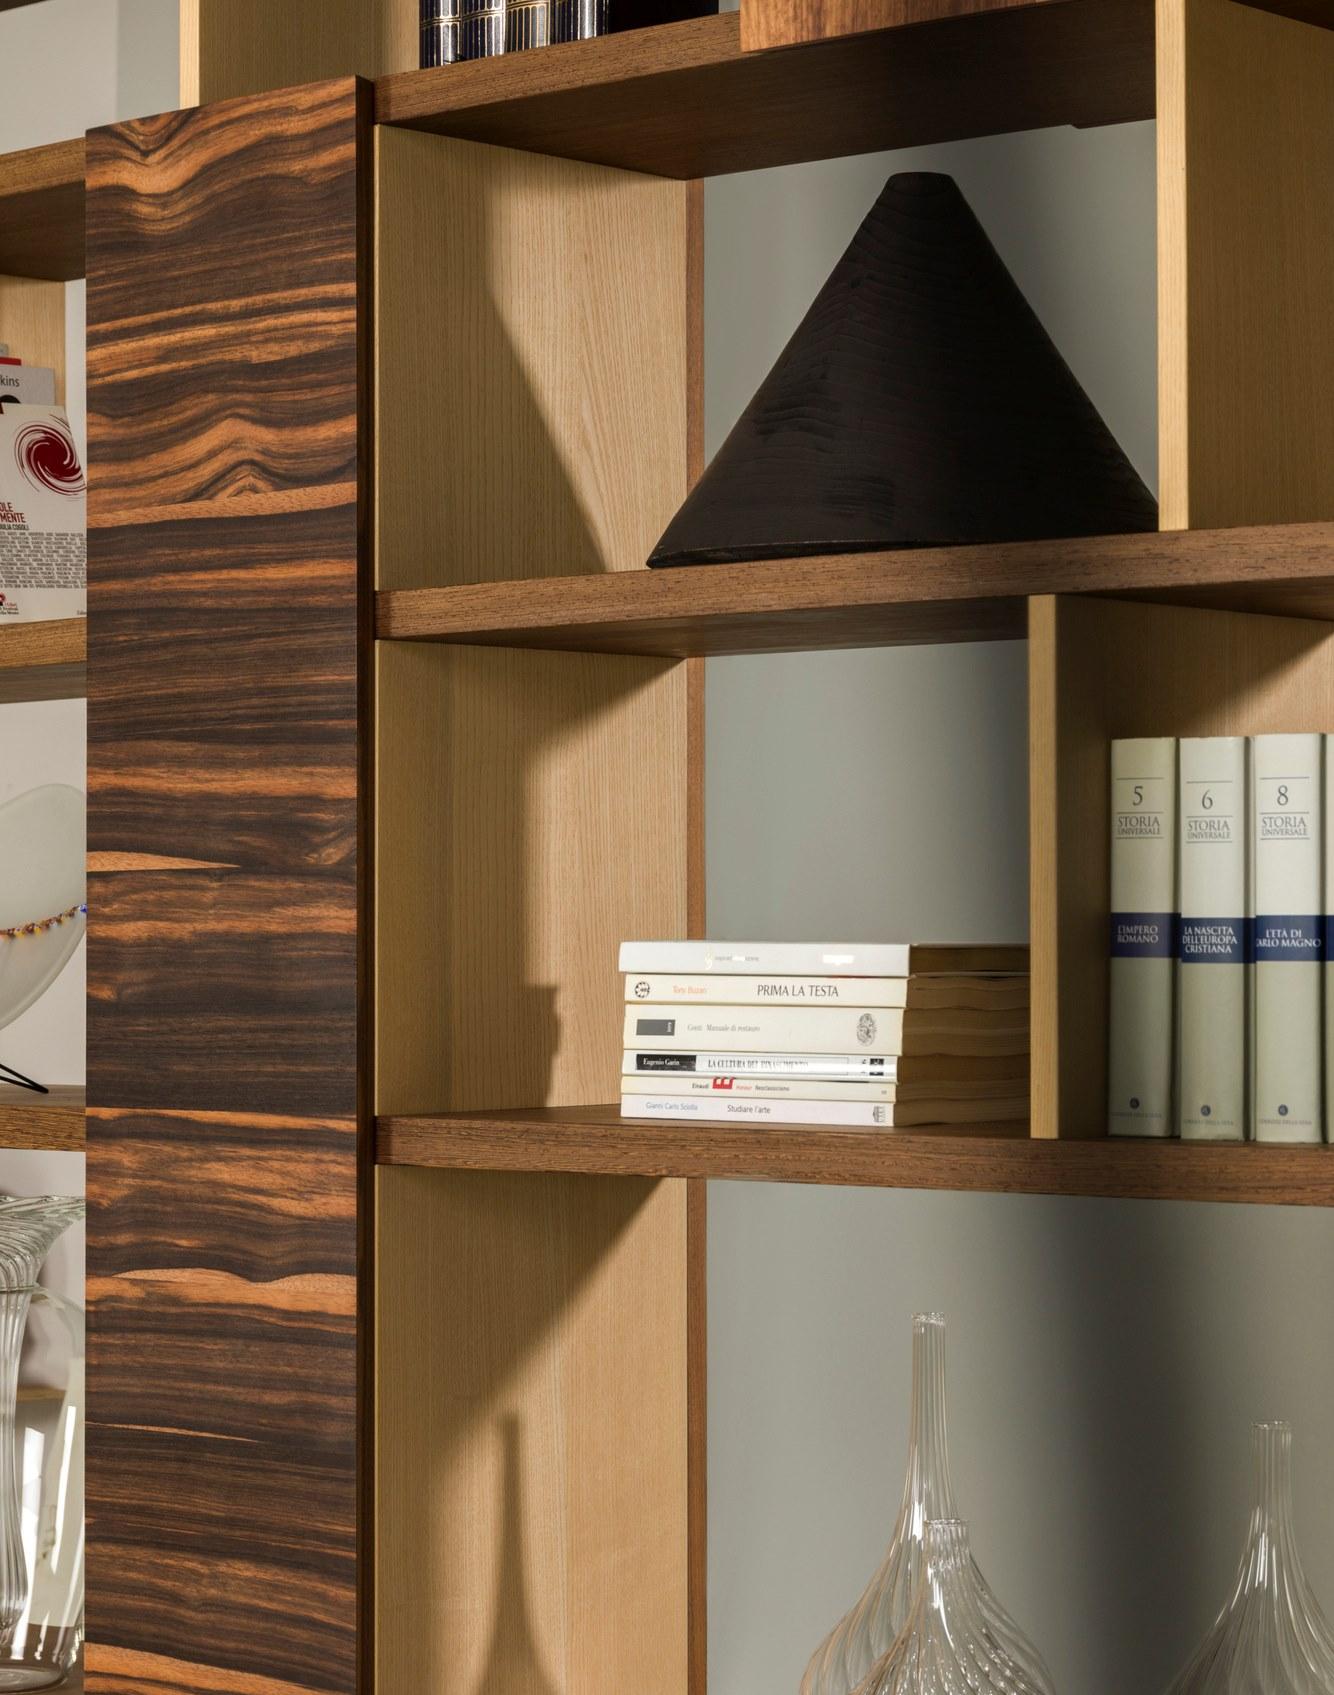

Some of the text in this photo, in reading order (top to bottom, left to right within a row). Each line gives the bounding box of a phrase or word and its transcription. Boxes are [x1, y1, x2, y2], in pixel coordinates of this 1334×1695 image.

[1132, 785, 1143, 806] 5
[1201, 789, 1213, 810] 6
[1277, 785, 1289, 806] 8
[1118, 816, 1160, 828] STORIA
[1187, 819, 1231, 831] STORIA
[1261, 816, 1306, 828] STORIA
[1117, 827, 1160, 835] UNIVERSALE
[1187, 831, 1231, 840] UNIVERSALE
[1261, 827, 1308, 836] UNIVERSALE
[1184, 926, 1234, 936] LA NASCITA
[1290, 928, 1302, 938] DI
[1116, 934, 1159, 944] ROMANO
[1182, 935, 1238, 945] DELL'EUROPA
[1256, 938, 1322, 948] ARLO MAGNO
[1184, 944, 1233, 954] CRISTIANA
[757, 984, 790, 997] PRIMA
[791, 984, 805, 997] LA
[808, 984, 840, 998] TESTA
[727, 1104, 754, 1114] Studiare
[754, 1104, 771, 1114] l'arte
